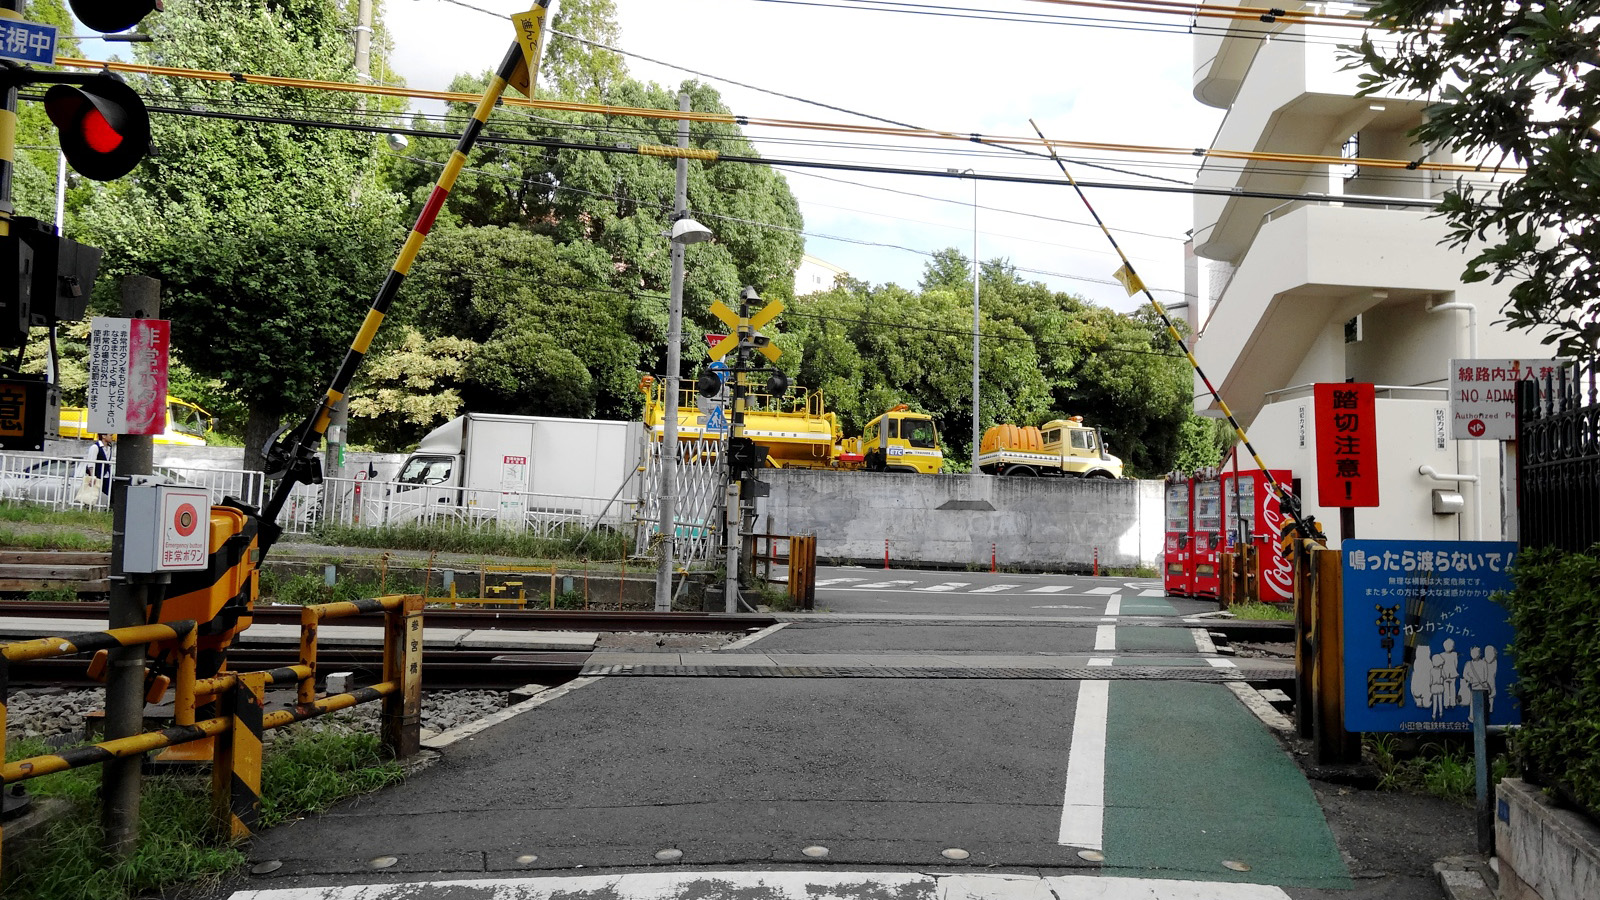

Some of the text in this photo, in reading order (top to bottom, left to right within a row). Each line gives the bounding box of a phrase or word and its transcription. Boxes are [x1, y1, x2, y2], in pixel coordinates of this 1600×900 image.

[100, 330, 111, 388] 非常の場合以外に
[137, 323, 160, 428] 非常ボタン
[1461, 389, 1479, 403] NO
[1455, 411, 1499, 420] Authorized
[1333, 390, 1360, 500] 踏切注意！
[165, 541, 189, 549] Emergency
[164, 550, 203, 562] 非常ボタン
[1349, 550, 1513, 572] 鳴ったら渡らないで！
[1440, 604, 1469, 620] カンカン
[1403, 620, 1476, 638] カンカンカンカン
[1400, 721, 1470, 731] 小田急電鉄株式会社
